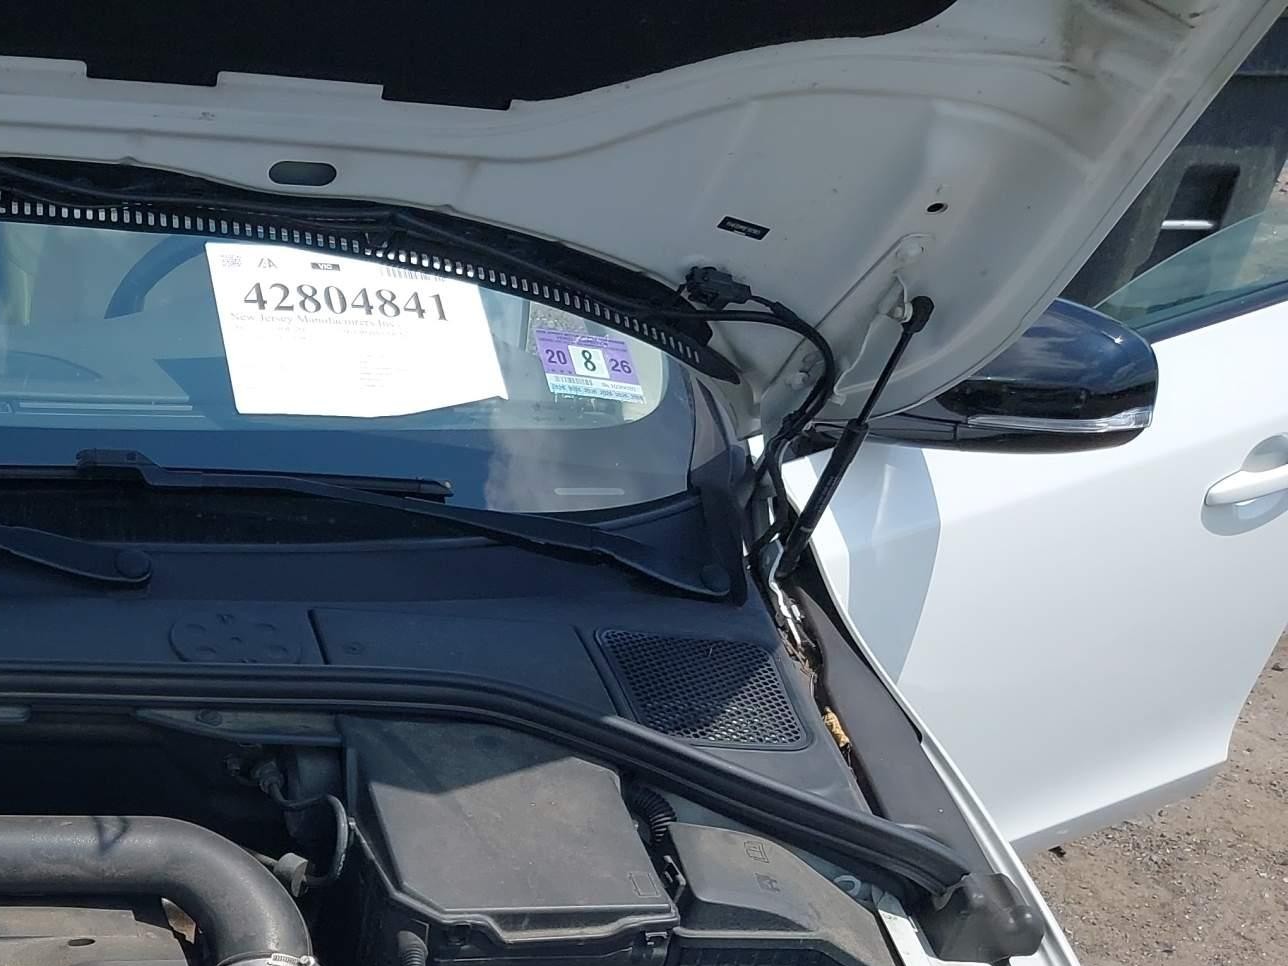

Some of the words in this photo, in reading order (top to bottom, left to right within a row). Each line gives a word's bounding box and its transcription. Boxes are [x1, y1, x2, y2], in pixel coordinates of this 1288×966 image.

[243, 281, 449, 322] 42804841
[544, 348, 568, 366] 20
[581, 349, 597, 372] 8
[608, 357, 633, 375] 26
